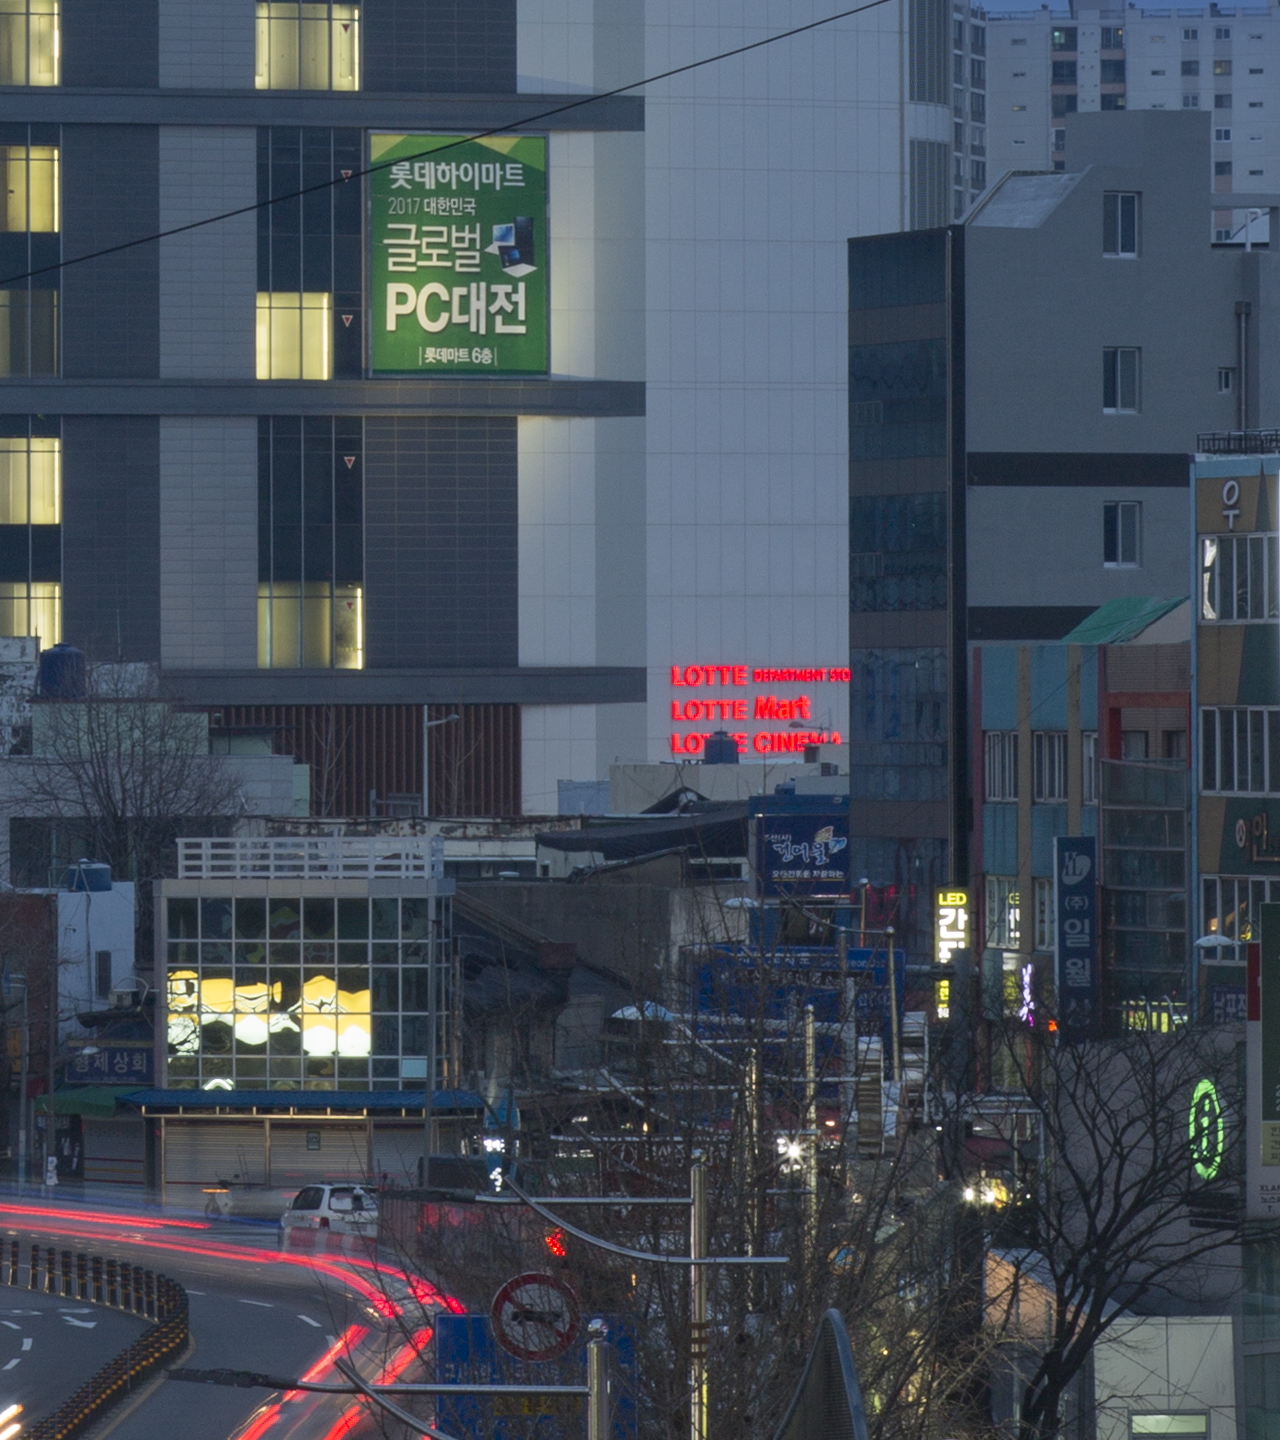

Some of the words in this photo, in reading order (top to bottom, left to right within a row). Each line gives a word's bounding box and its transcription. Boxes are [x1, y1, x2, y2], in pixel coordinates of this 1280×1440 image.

[390, 161, 526, 191] 롯데하이마트
[388, 197, 421, 215] 2017
[423, 197, 477, 216] 대한민국
[383, 222, 482, 273] 글로벌
[386, 281, 527, 335] PC대전
[424, 346, 471, 364] 롯데마트
[472, 346, 493, 364] 6층
[671, 665, 748, 686] LOTTE
[753, 667, 827, 683] DEPARTMENT
[671, 699, 748, 721] LOTTE
[753, 694, 811, 720] Mart
[772, 842, 830, 866] 건어물
[938, 892, 968, 906] LED
[1064, 895, 1089, 911] (주)
